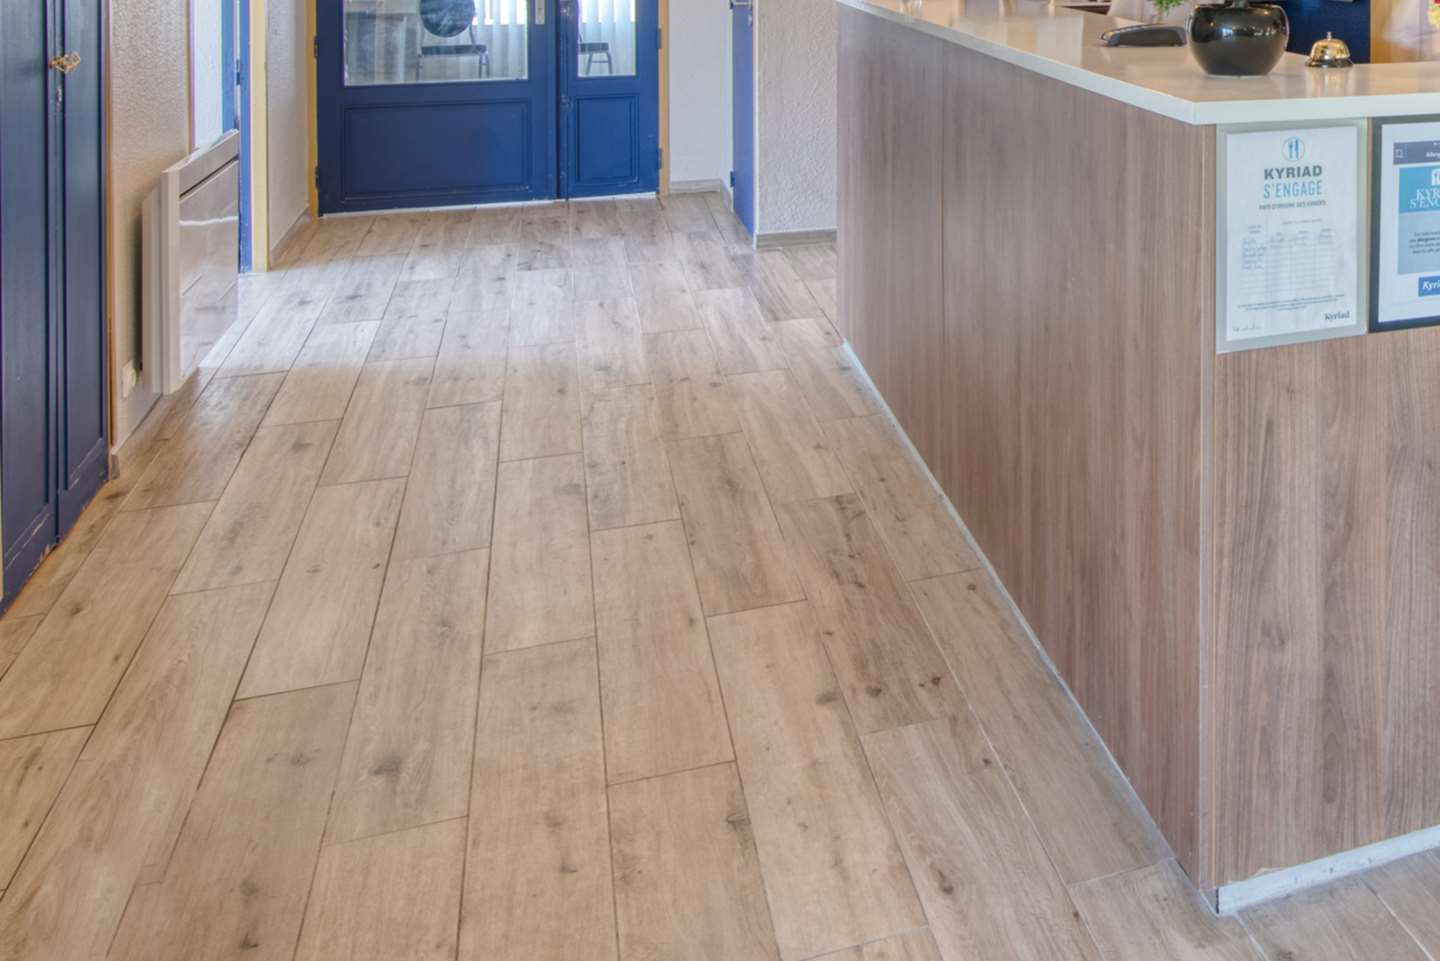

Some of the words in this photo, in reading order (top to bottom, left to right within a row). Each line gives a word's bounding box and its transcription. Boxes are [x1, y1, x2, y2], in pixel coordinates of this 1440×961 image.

[1264, 164, 1322, 180] KYRIAD
[1263, 180, 1322, 199] S'ENGAGE
[1324, 310, 1350, 322] Kyriad
